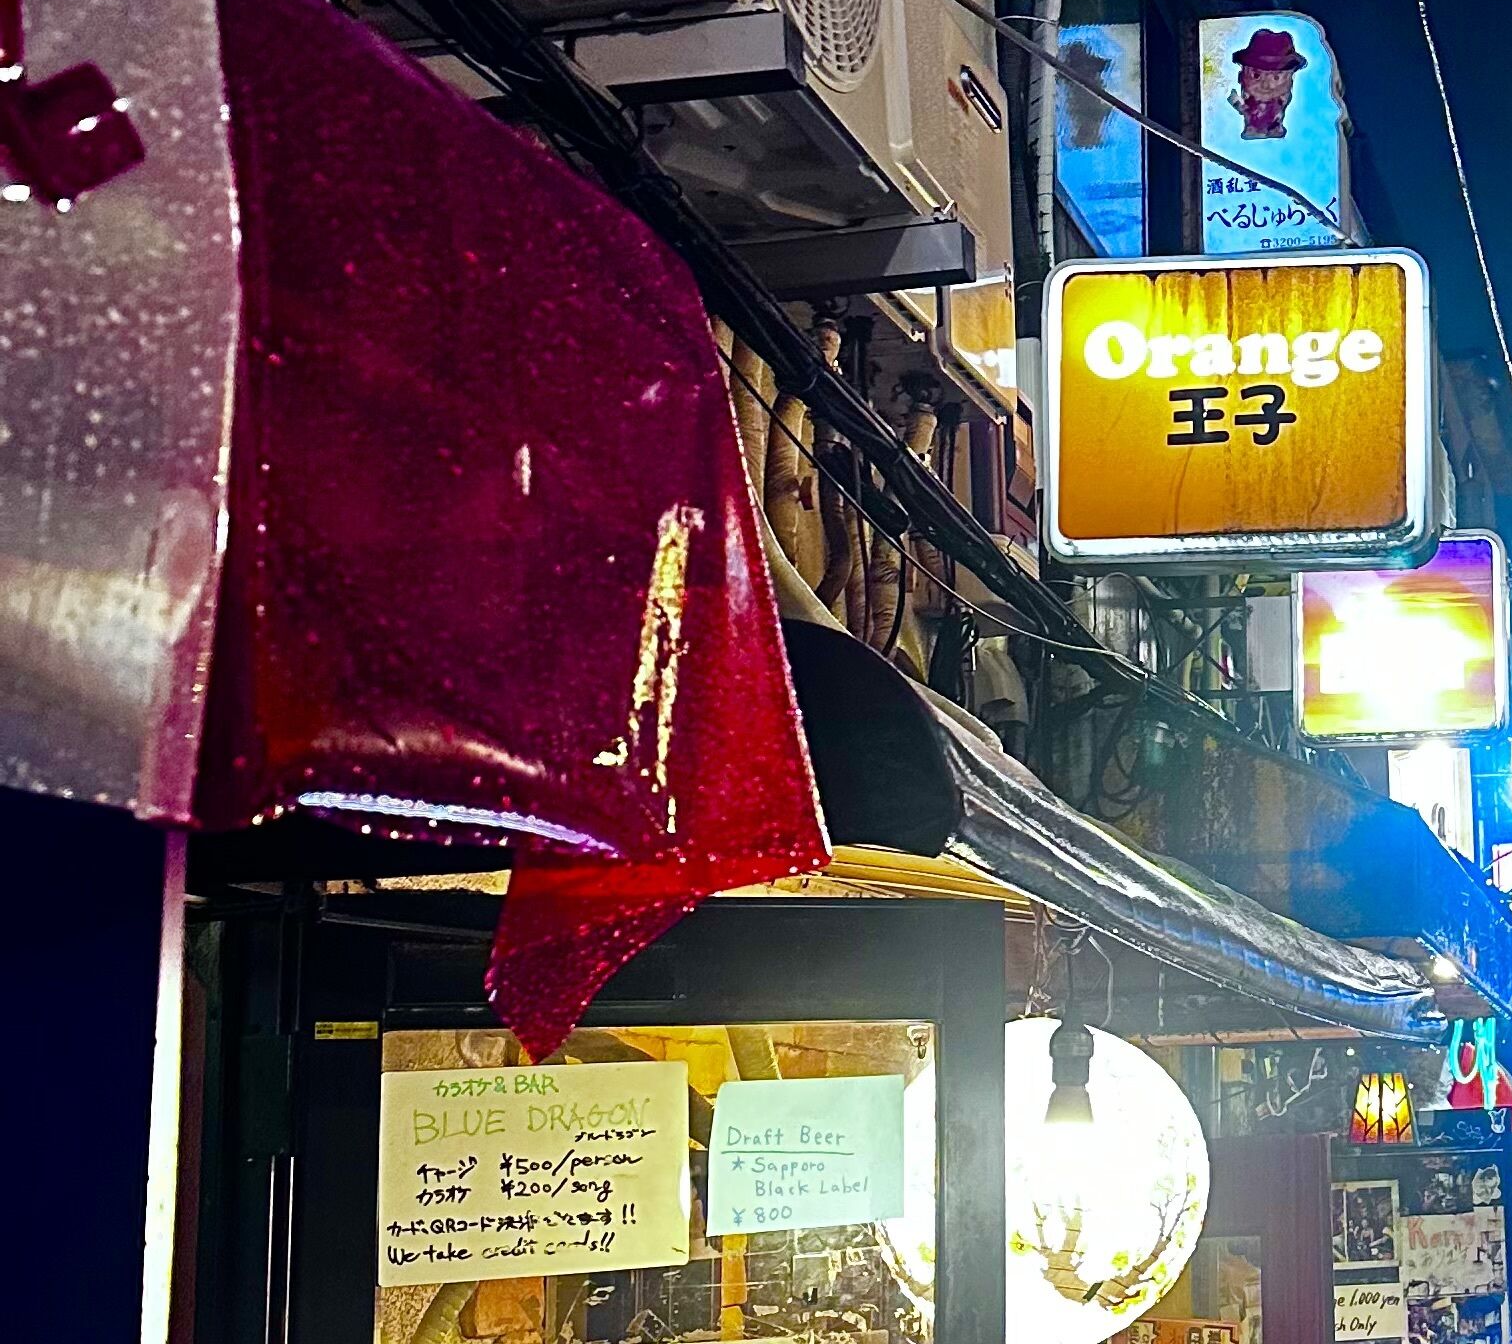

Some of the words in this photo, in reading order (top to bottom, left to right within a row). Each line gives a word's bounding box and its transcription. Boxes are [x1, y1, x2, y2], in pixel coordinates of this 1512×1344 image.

[1084, 321, 1383, 387] Orange
[1167, 384, 1297, 446] 王子
[514, 1074, 559, 1094] BAR
[414, 1107, 506, 1146] BLUE
[527, 1097, 650, 1133] DRAGON
[727, 1126, 784, 1146] Draft
[800, 1125, 846, 1145] Beer
[416, 1156, 478, 1184] チャージ
[751, 1157, 825, 1180] Sapporo
[416, 1186, 472, 1206] カラオケ
[755, 1180, 809, 1197] Black
[820, 1176, 868, 1194] Label
[387, 1245, 420, 1266] We
[423, 1241, 473, 1264] take
[1380, 1296, 1400, 1309] yen
[1349, 1314, 1377, 1336] Only
